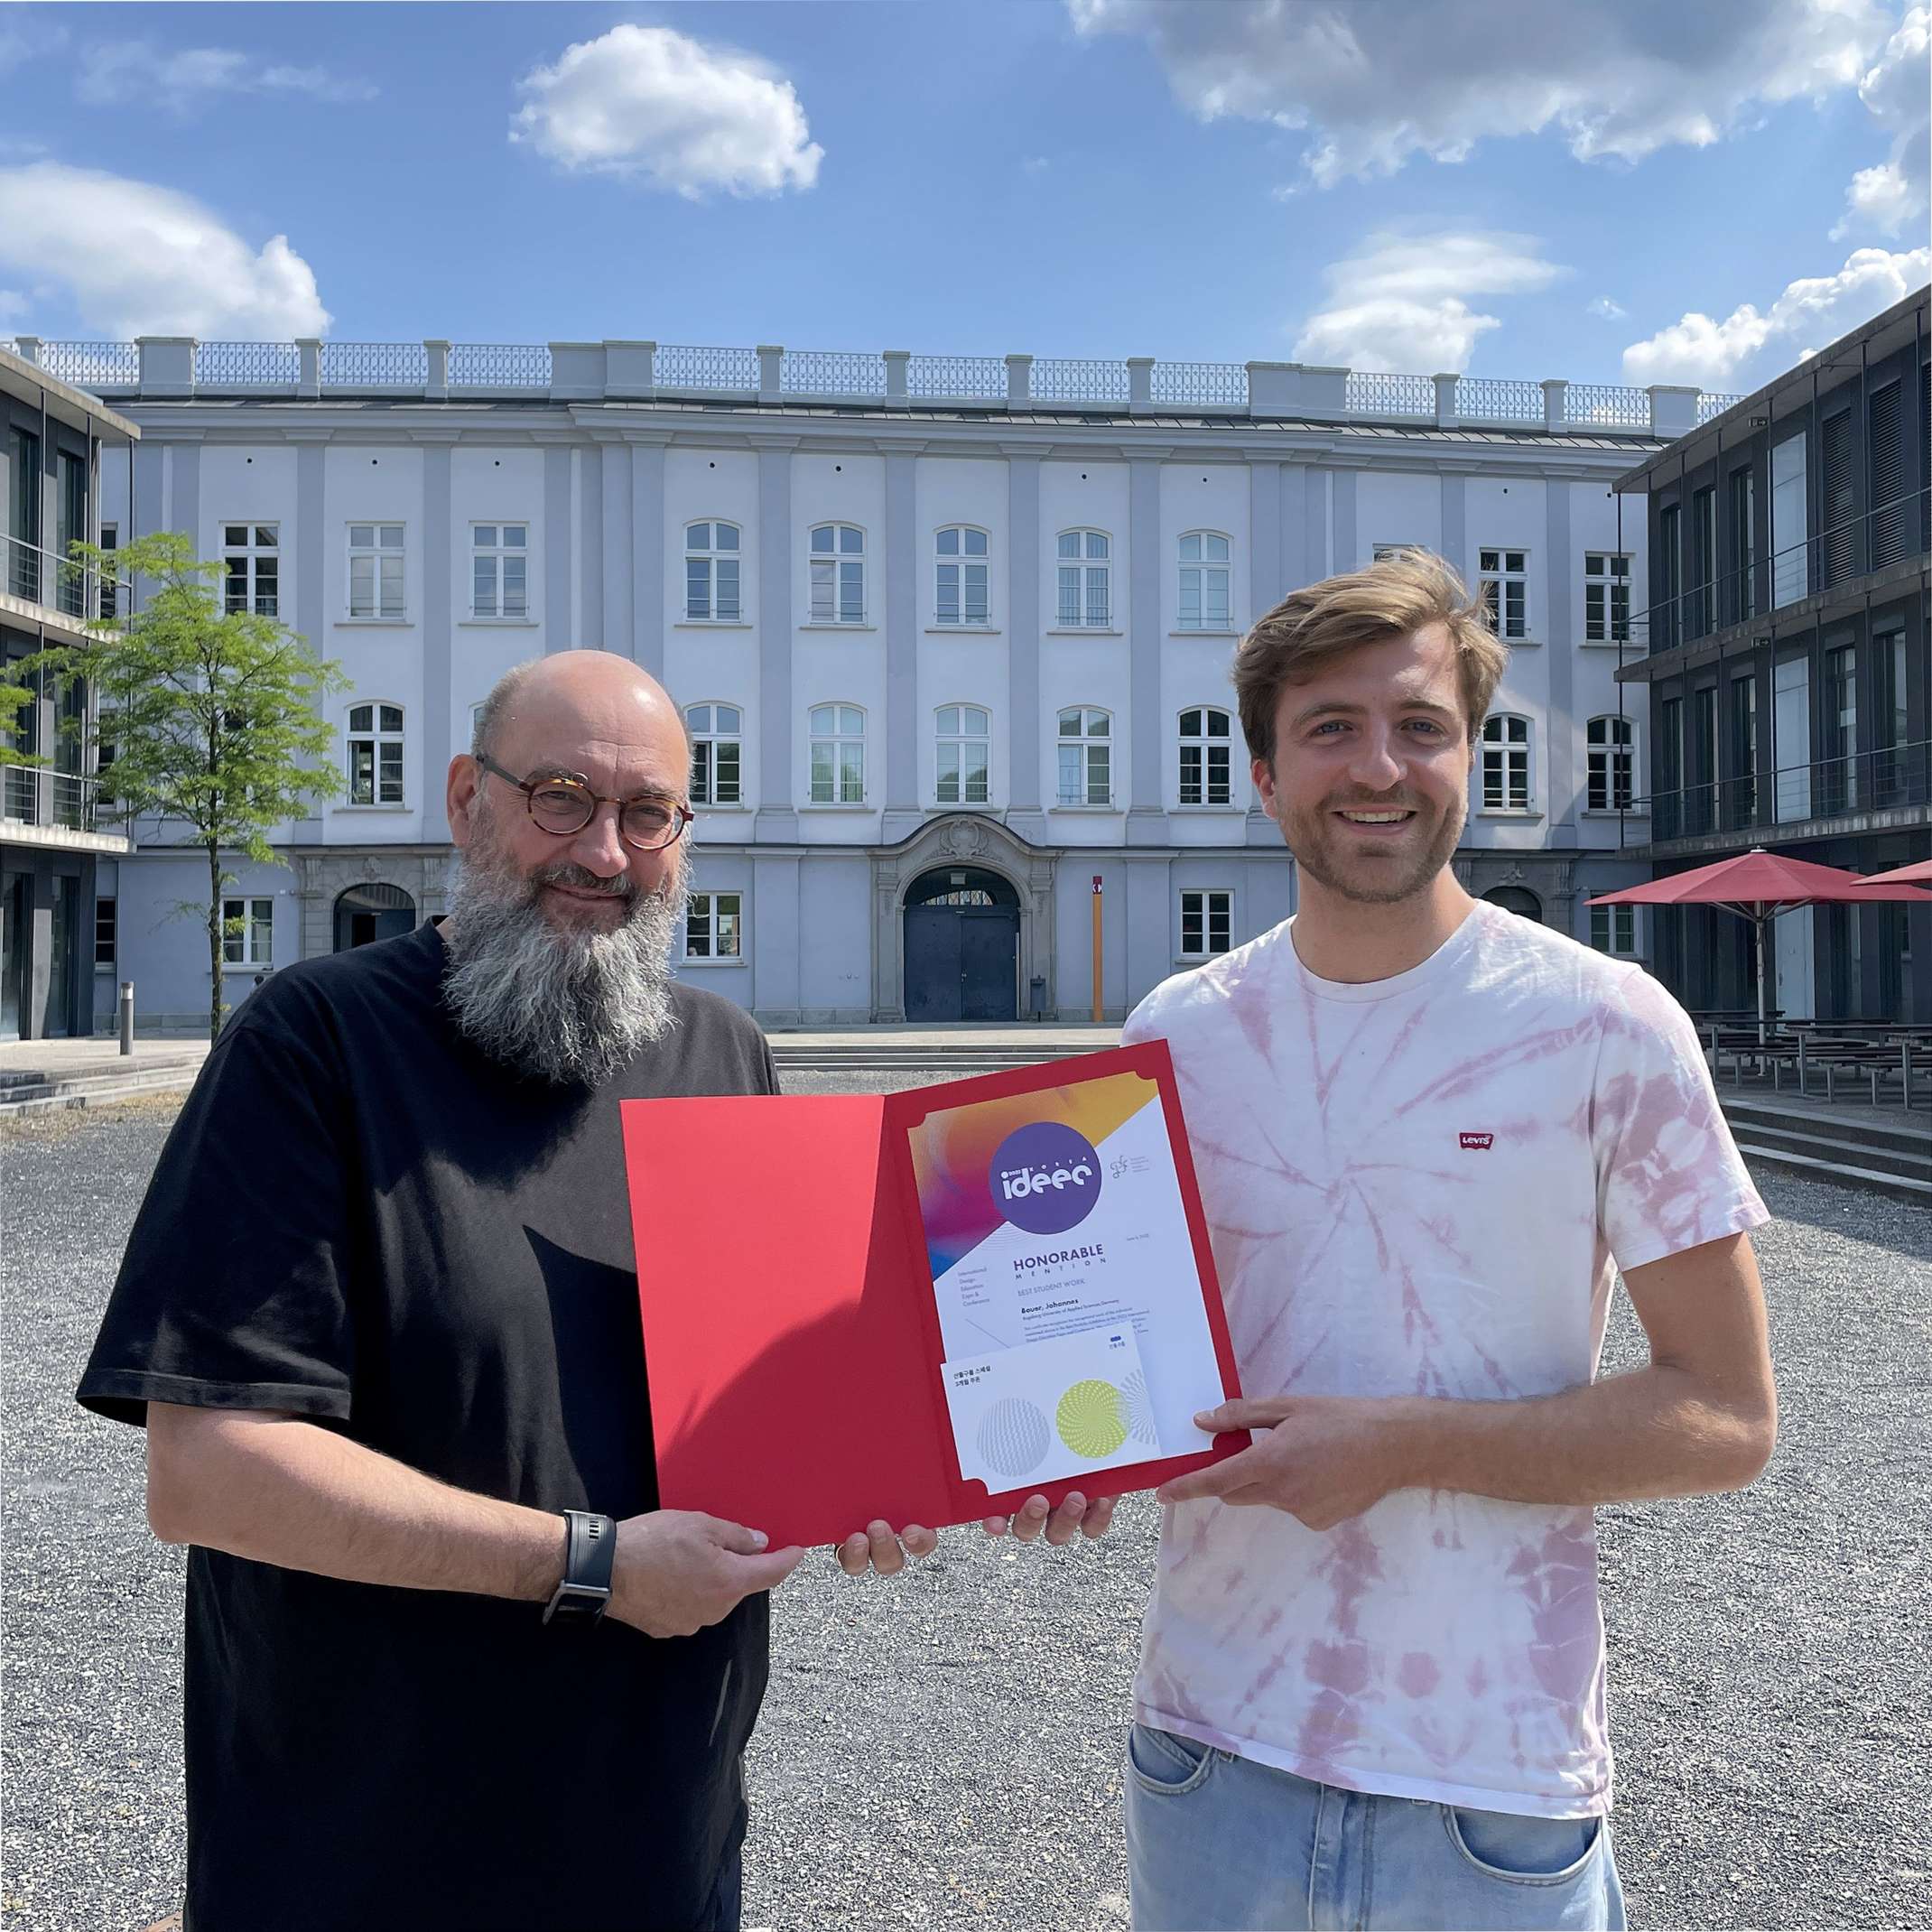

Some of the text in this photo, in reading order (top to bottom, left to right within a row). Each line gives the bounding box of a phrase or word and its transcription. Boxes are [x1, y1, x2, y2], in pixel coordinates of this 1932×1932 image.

[1013, 1244, 1103, 1271] HONORABLE
[1015, 1258, 1107, 1280] MENTION
[1033, 1281, 1063, 1294] STUDENT
[1063, 1278, 1086, 1287] WORK
[1045, 1298, 1079, 1310] Johannes
